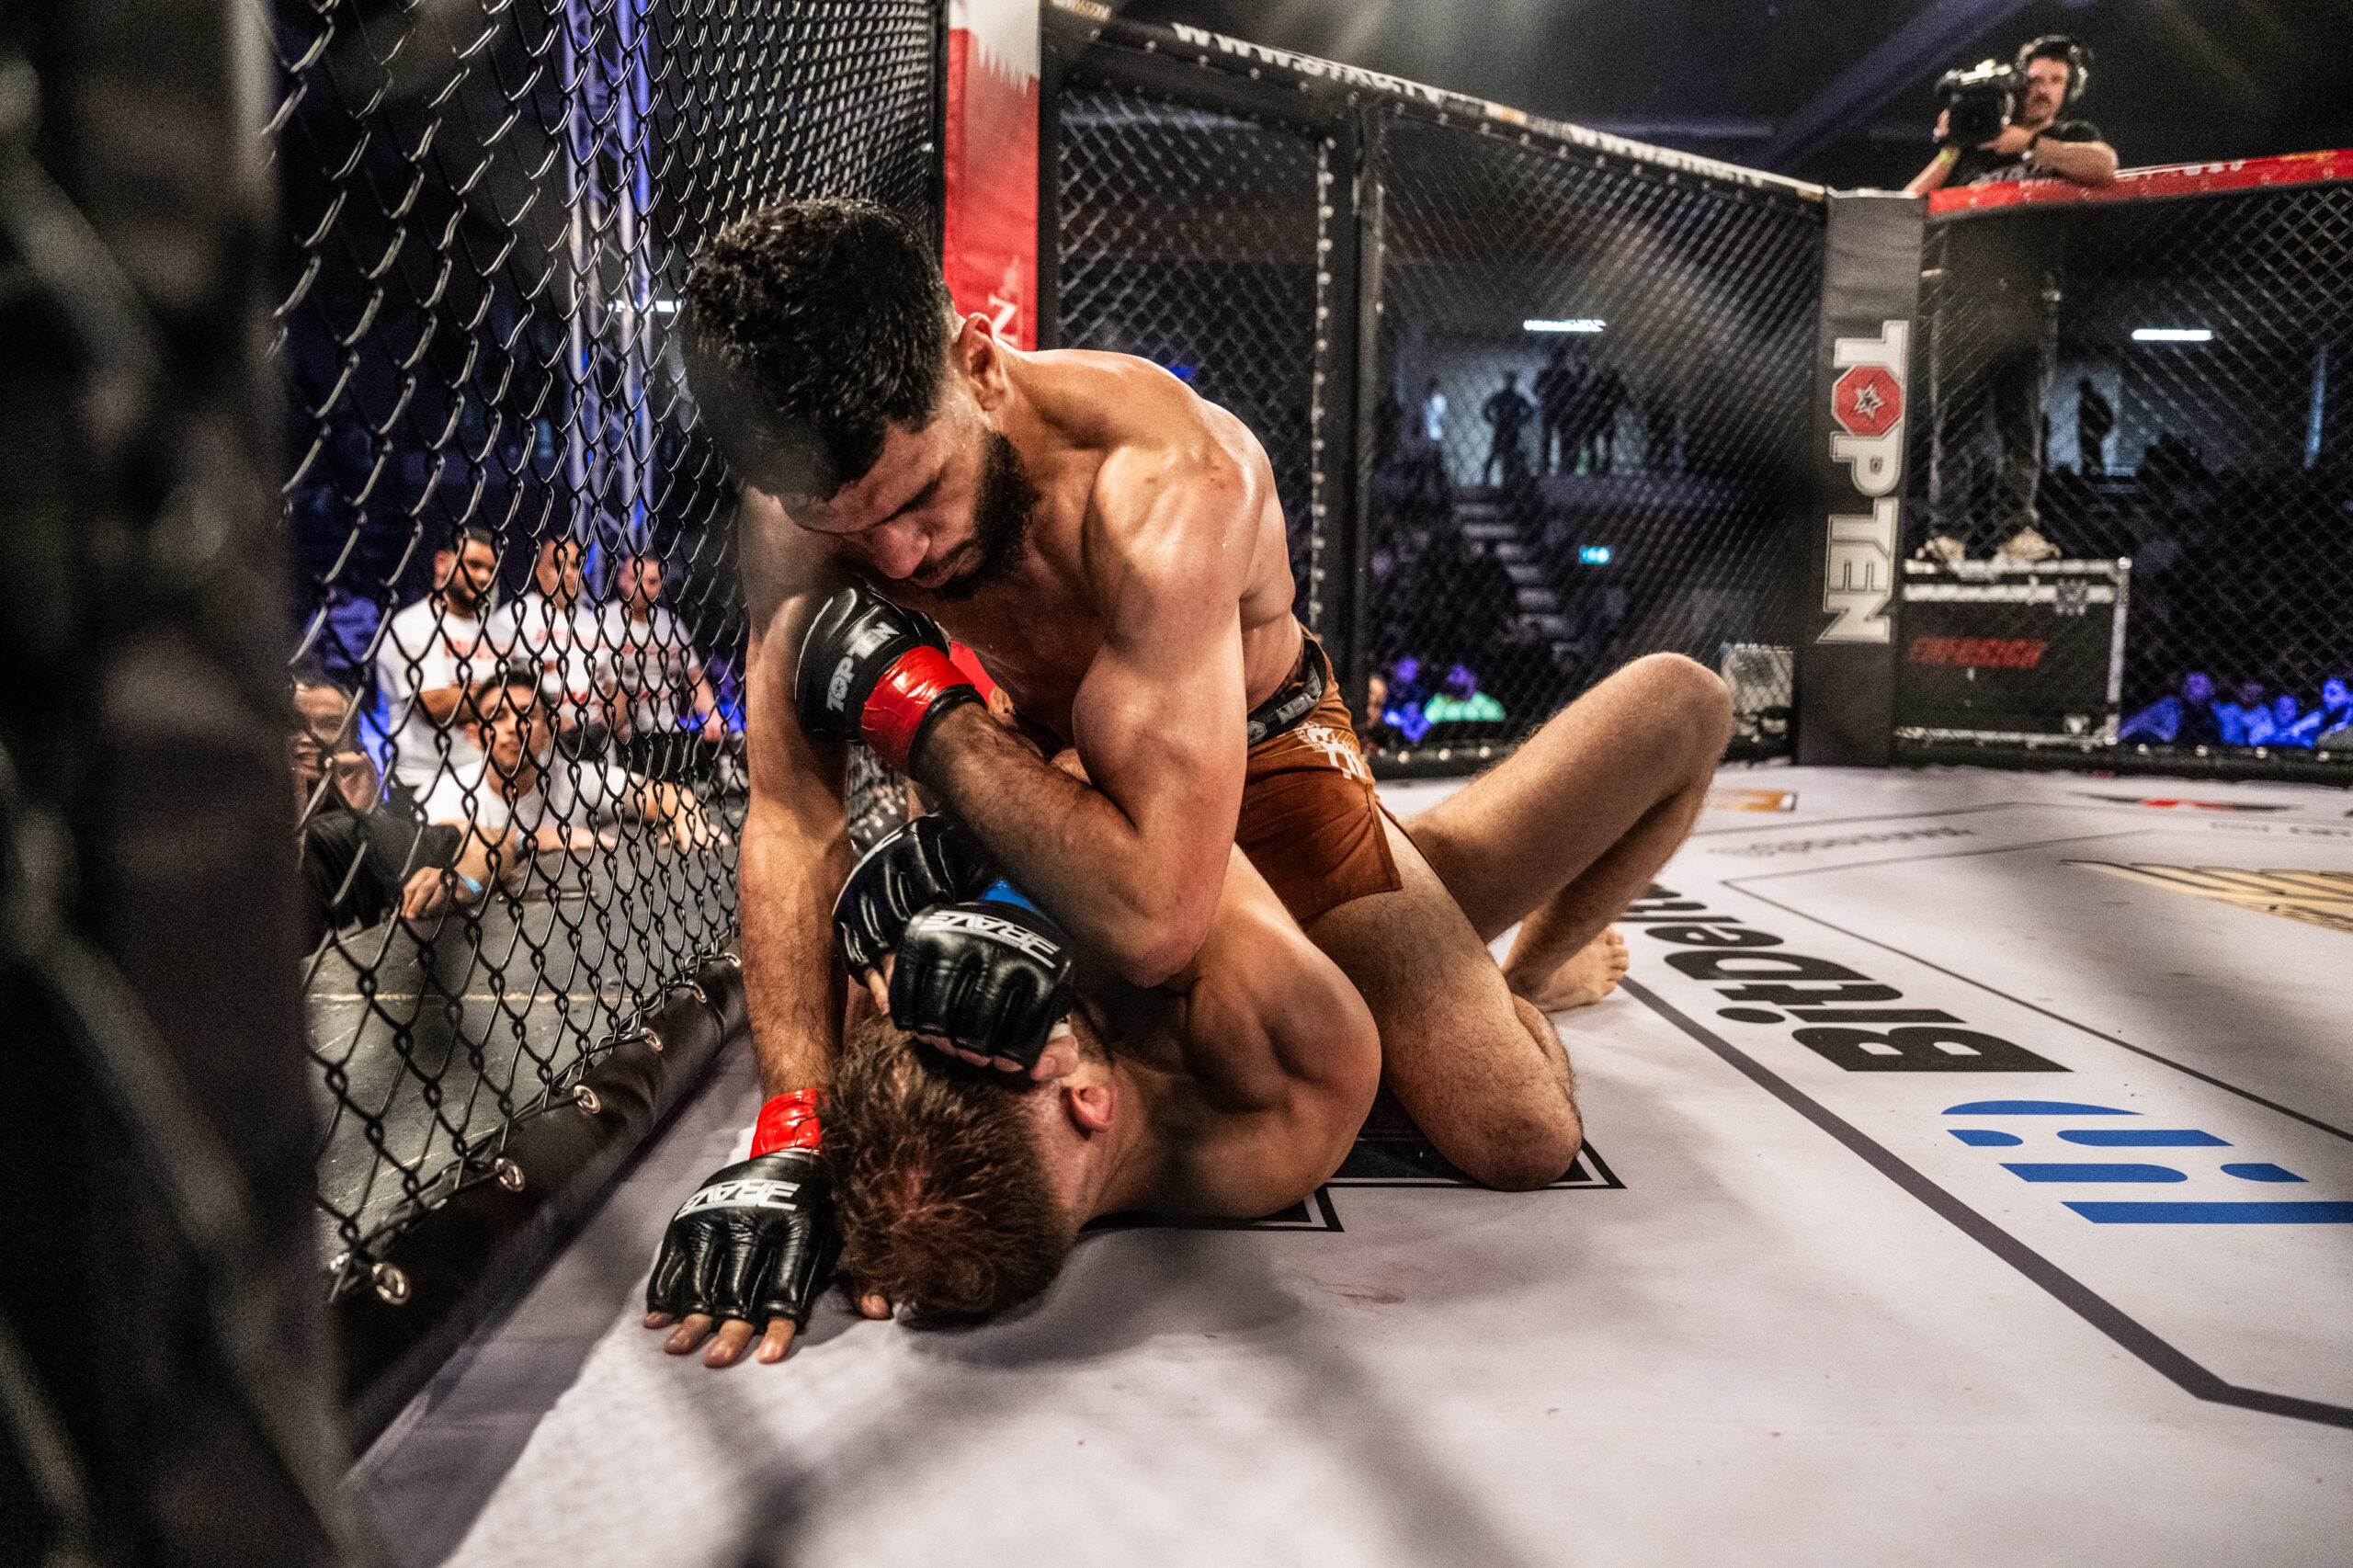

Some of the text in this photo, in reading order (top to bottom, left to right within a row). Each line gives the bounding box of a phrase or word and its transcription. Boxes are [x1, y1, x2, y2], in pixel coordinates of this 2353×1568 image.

[1816, 320, 1909, 643] TOP TEN
[826, 621, 901, 712] TOP TEN
[919, 910, 1061, 970] BRAVE
[674, 1179, 801, 1221] BRAVE
